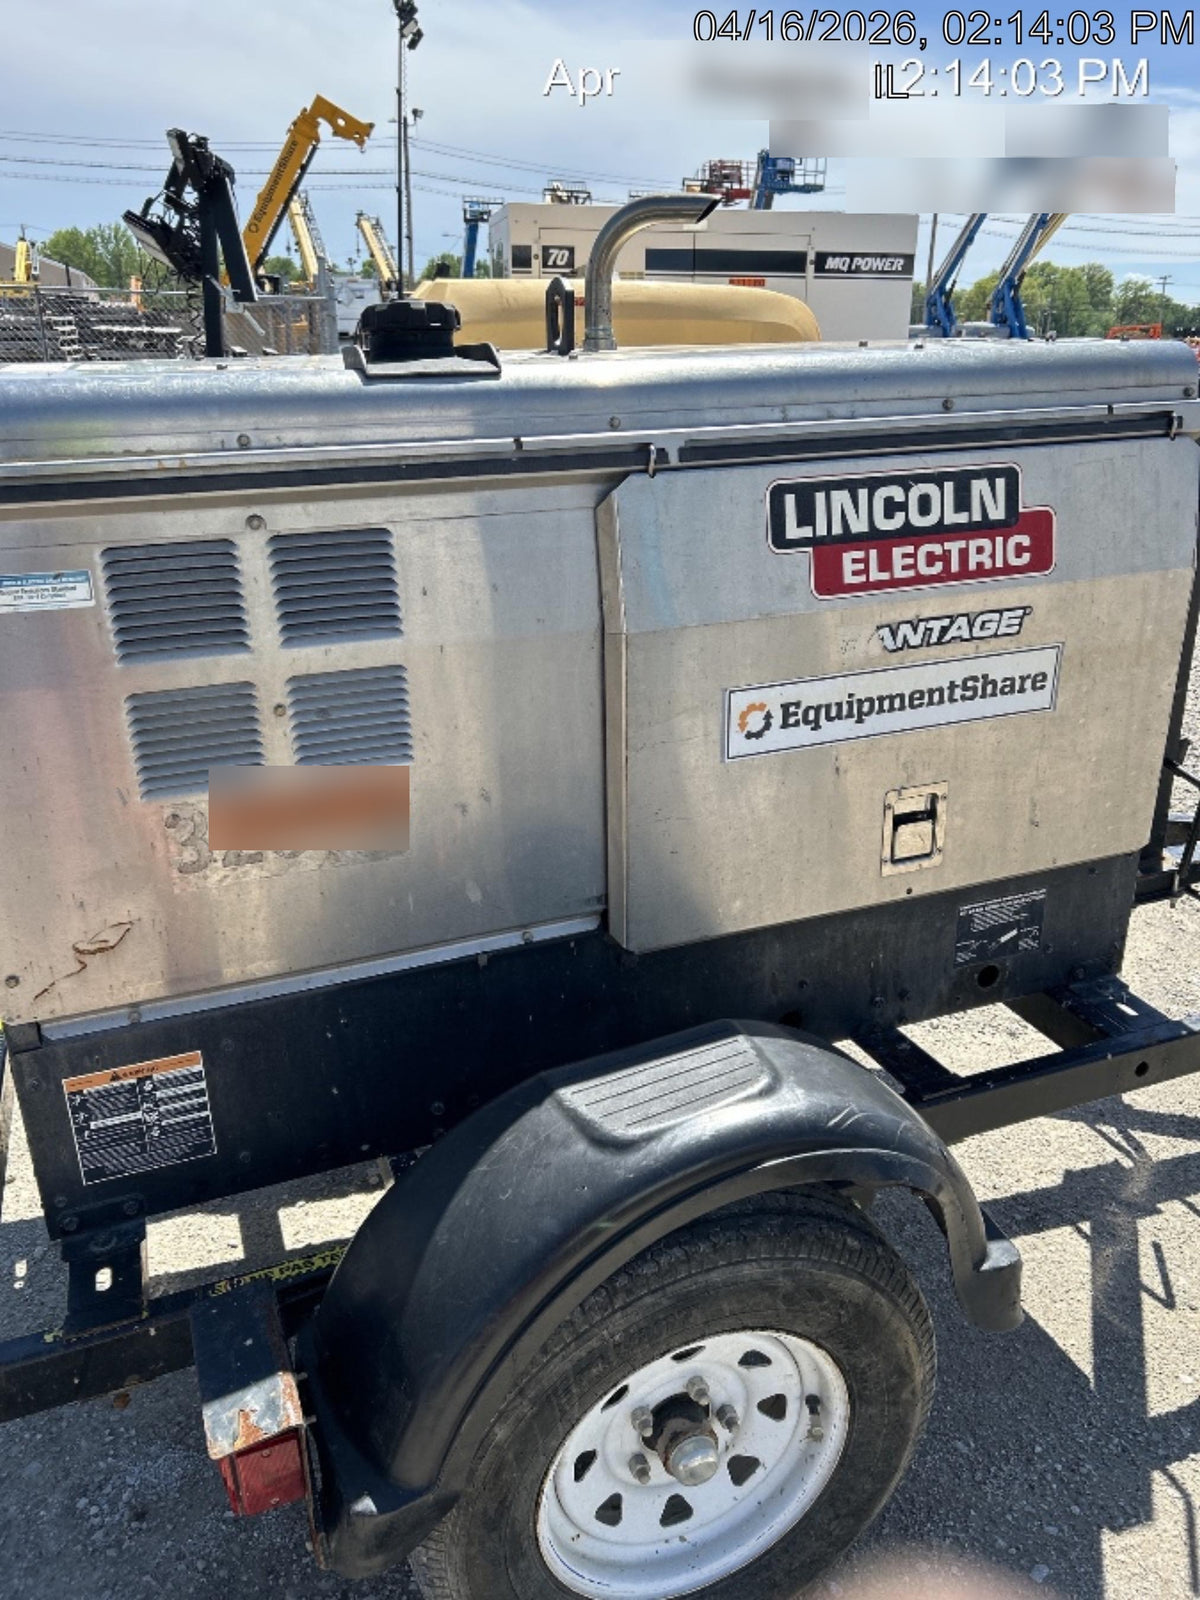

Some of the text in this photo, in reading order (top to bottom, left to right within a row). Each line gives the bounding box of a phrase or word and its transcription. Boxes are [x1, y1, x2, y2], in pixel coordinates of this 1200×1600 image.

[253, 140, 299, 223] EquipmentShare
[547, 248, 569, 266] 70
[825, 256, 904, 272] MQ POWER
[784, 477, 1006, 540] LINCOLN
[842, 534, 1031, 584] ELECTRIC
[779, 671, 1048, 731] EquipmentShare
